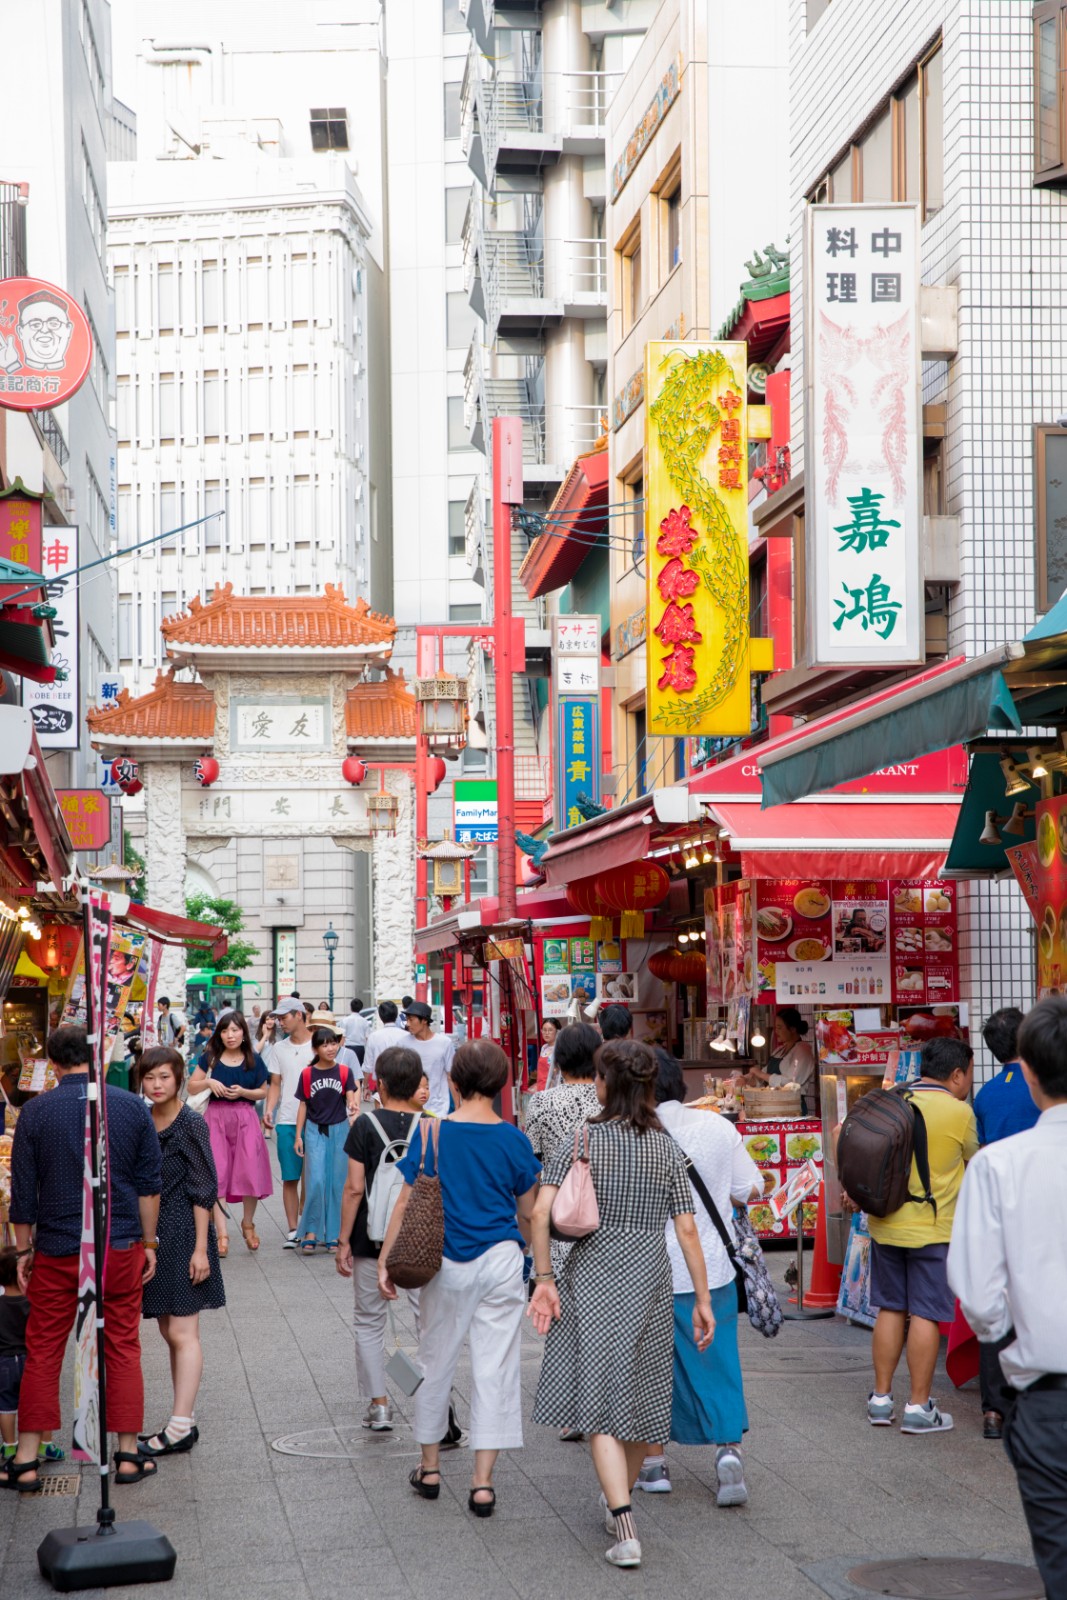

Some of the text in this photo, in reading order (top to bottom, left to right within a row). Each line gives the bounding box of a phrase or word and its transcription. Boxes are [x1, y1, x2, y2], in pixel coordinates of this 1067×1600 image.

[832, 487, 902, 641] 嘉鴻
[558, 624, 597, 635] マサニ
[30, 692, 72, 700] KOBE BEEF
